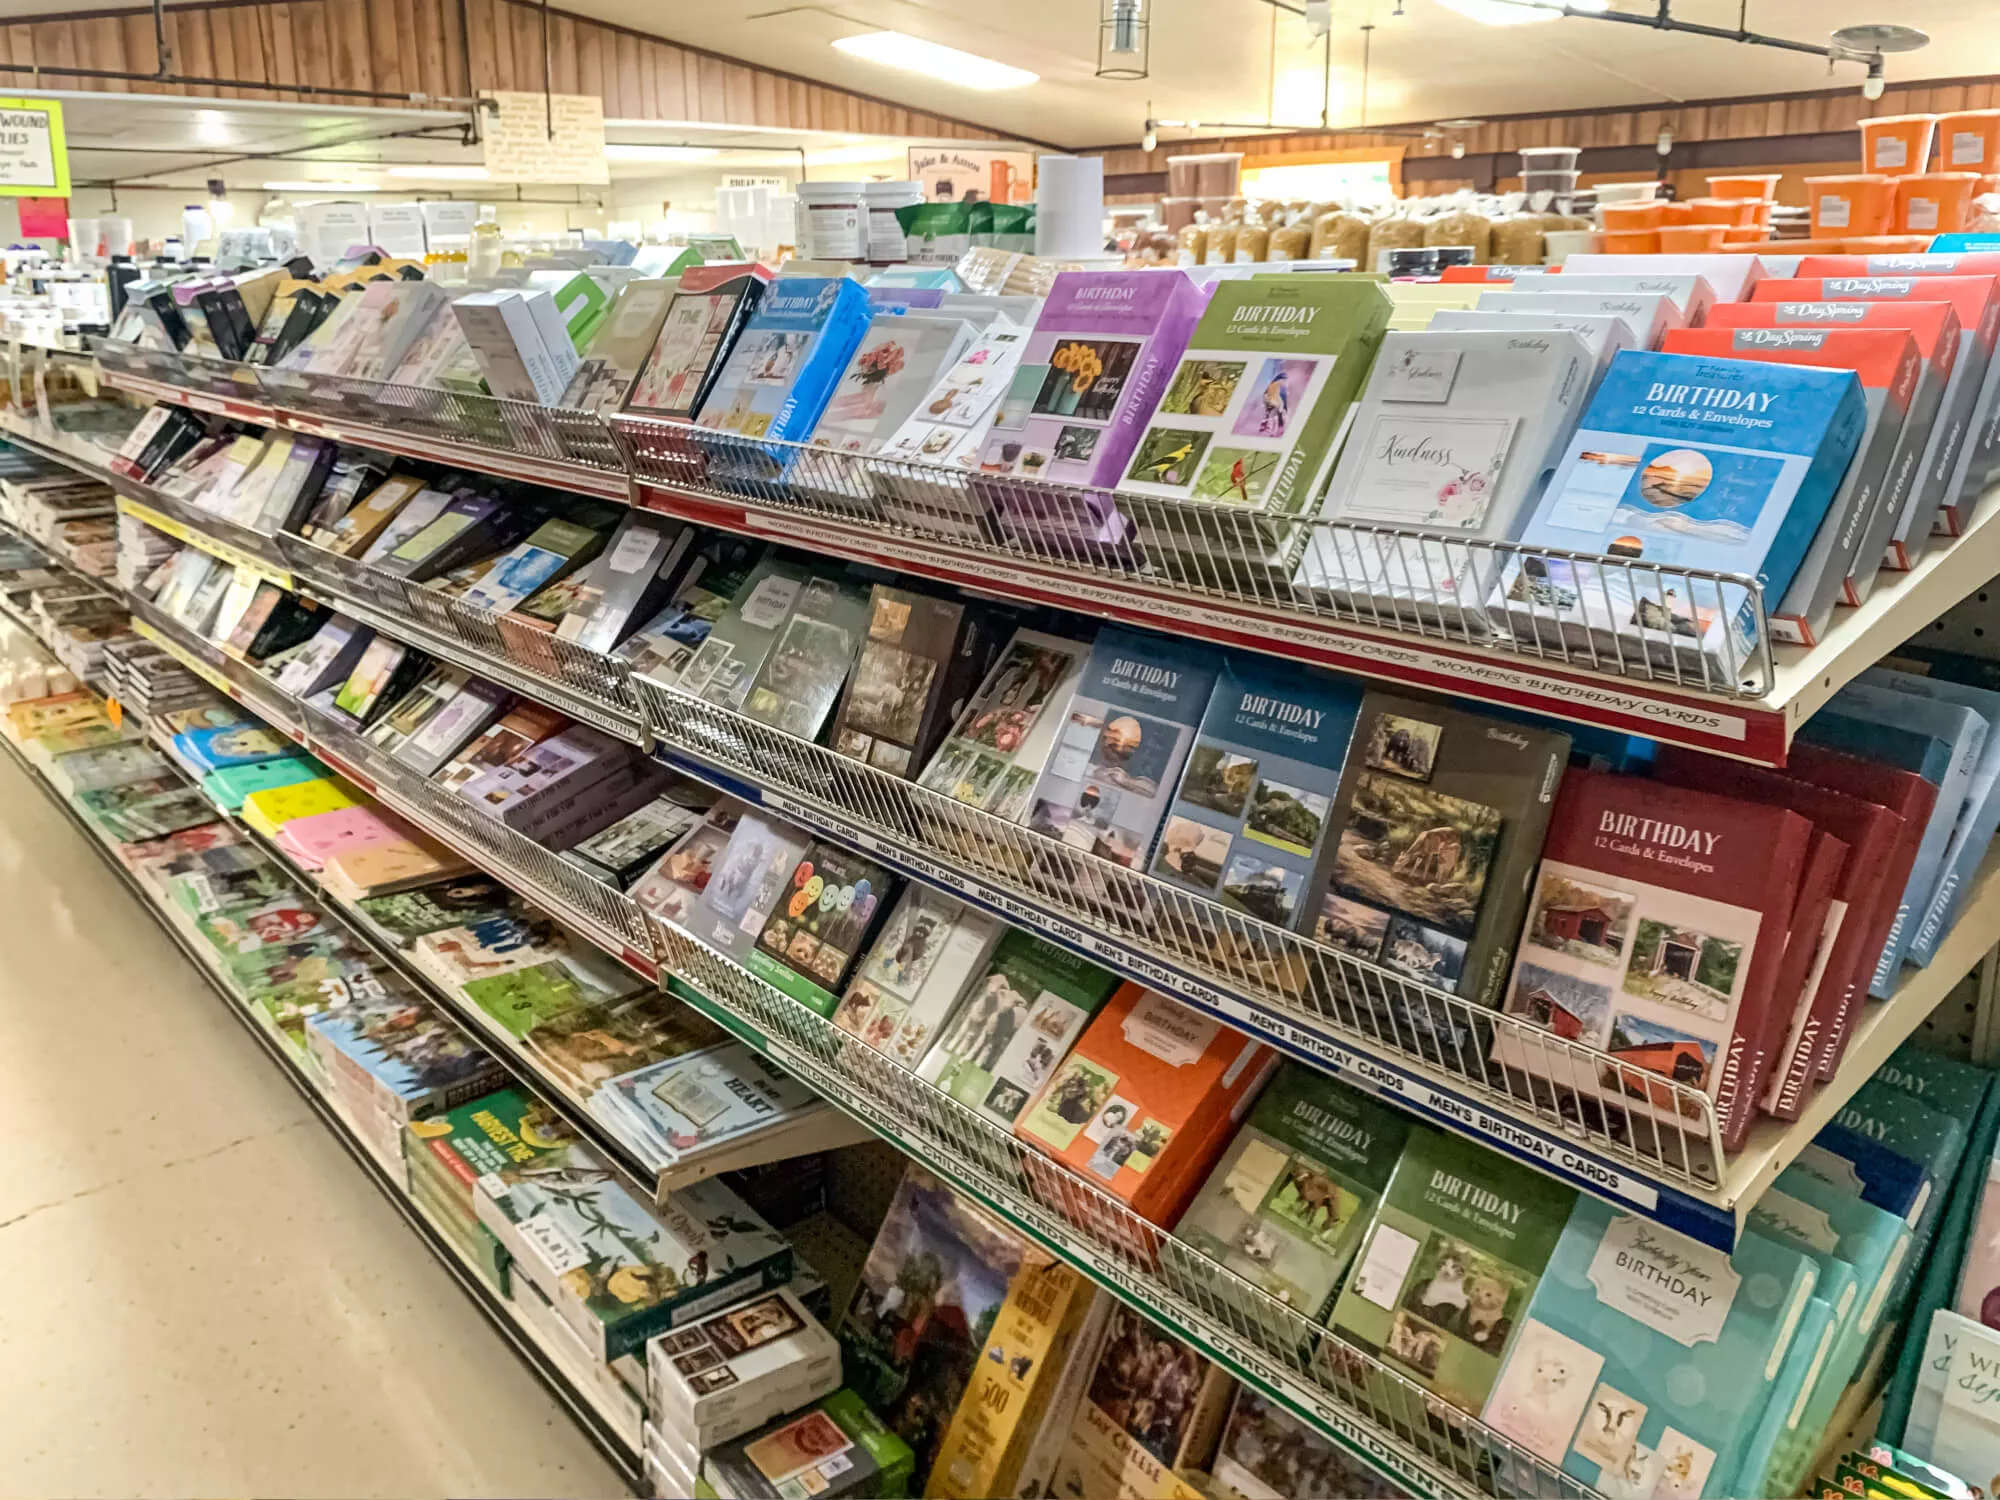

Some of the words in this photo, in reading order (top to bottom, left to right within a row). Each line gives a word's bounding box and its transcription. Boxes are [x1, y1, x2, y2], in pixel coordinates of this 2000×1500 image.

[940, 154, 949, 163] &
[1075, 287, 1138, 300] BIRTHDAY
[1843, 278, 1911, 294] DaySpring
[1232, 305, 1322, 323] BIRTHDAY
[1797, 303, 1865, 322] DaySpring
[1507, 339, 1551, 353] Birthday
[1754, 330, 1823, 346] DaySpring
[1121, 355, 1159, 425] BIRTHDAY
[1646, 382, 1780, 413] BIRTHDAY
[1632, 405, 1647, 415] 12
[1648, 405, 1687, 419] Cards
[1688, 409, 1701, 420] &
[1703, 410, 1774, 429] Envelopes
[1376, 434, 1452, 467] Kindness
[1887, 451, 1914, 514] Birthday
[1842, 484, 1871, 550] Birthday
[1111, 658, 1183, 689] BIRTHDAY
[1273, 626, 1361, 651] BIRTHDAY
[1361, 644, 1420, 664] CARDS
[1526, 678, 1644, 710] BIRTHDAY
[1643, 703, 1721, 729] CARDS
[535, 687, 580, 712] SYMPATHY
[583, 709, 633, 736] SYMPATHY
[1240, 693, 1327, 729] BIRTHDAY
[1599, 810, 1723, 855] BIRTHDAY
[1594, 836, 1608, 848] 12
[1609, 839, 1640, 856] Cards
[1642, 848, 1655, 860] &
[1657, 850, 1714, 873] Envelopes
[1919, 871, 1960, 953] BIRTHDAY
[1872, 902, 1911, 987] BIRTHDAY
[803, 808, 836, 831] BIRTHDAY
[836, 823, 860, 841] CARDS
[876, 842, 898, 858] MEN'S
[900, 851, 937, 875] BIRTHDAY
[938, 870, 966, 889] CARDS
[978, 889, 1003, 906] MEN'S
[1006, 901, 1049, 927] BIRTHDAY
[1051, 920, 1083, 944] CARDS
[1094, 942, 1124, 962] MEN'S
[1128, 956, 1179, 987] BIRTHDAY
[1181, 980, 1221, 1007] CARDS
[1250, 1011, 1286, 1036] MEN'S
[1291, 1029, 1353, 1067] BIRTHDAY
[1357, 1061, 1405, 1092] CARDS
[1429, 1093, 1473, 1122] MEN'S
[1478, 1116, 1557, 1158] BIRTHDAY
[1561, 1153, 1620, 1189] CARDS
[1778, 1014, 1822, 1113] BIRTHDAY
[724, 1077, 774, 1114] HEART
[1293, 1099, 1376, 1150] BIRTHDAY
[1430, 1169, 1527, 1224] BIRTHDAY
[859, 1103, 904, 1137] CARDS
[922, 1145, 1005, 1204] CHILDREN'S
[1013, 1205, 1069, 1248] CARDS
[1093, 1257, 1199, 1335] CHILDREN'S
[1210, 1336, 1284, 1390] CARDS
[1615, 1251, 1713, 1307] BIRTHDAY
[981, 1377, 1011, 1415] 500
